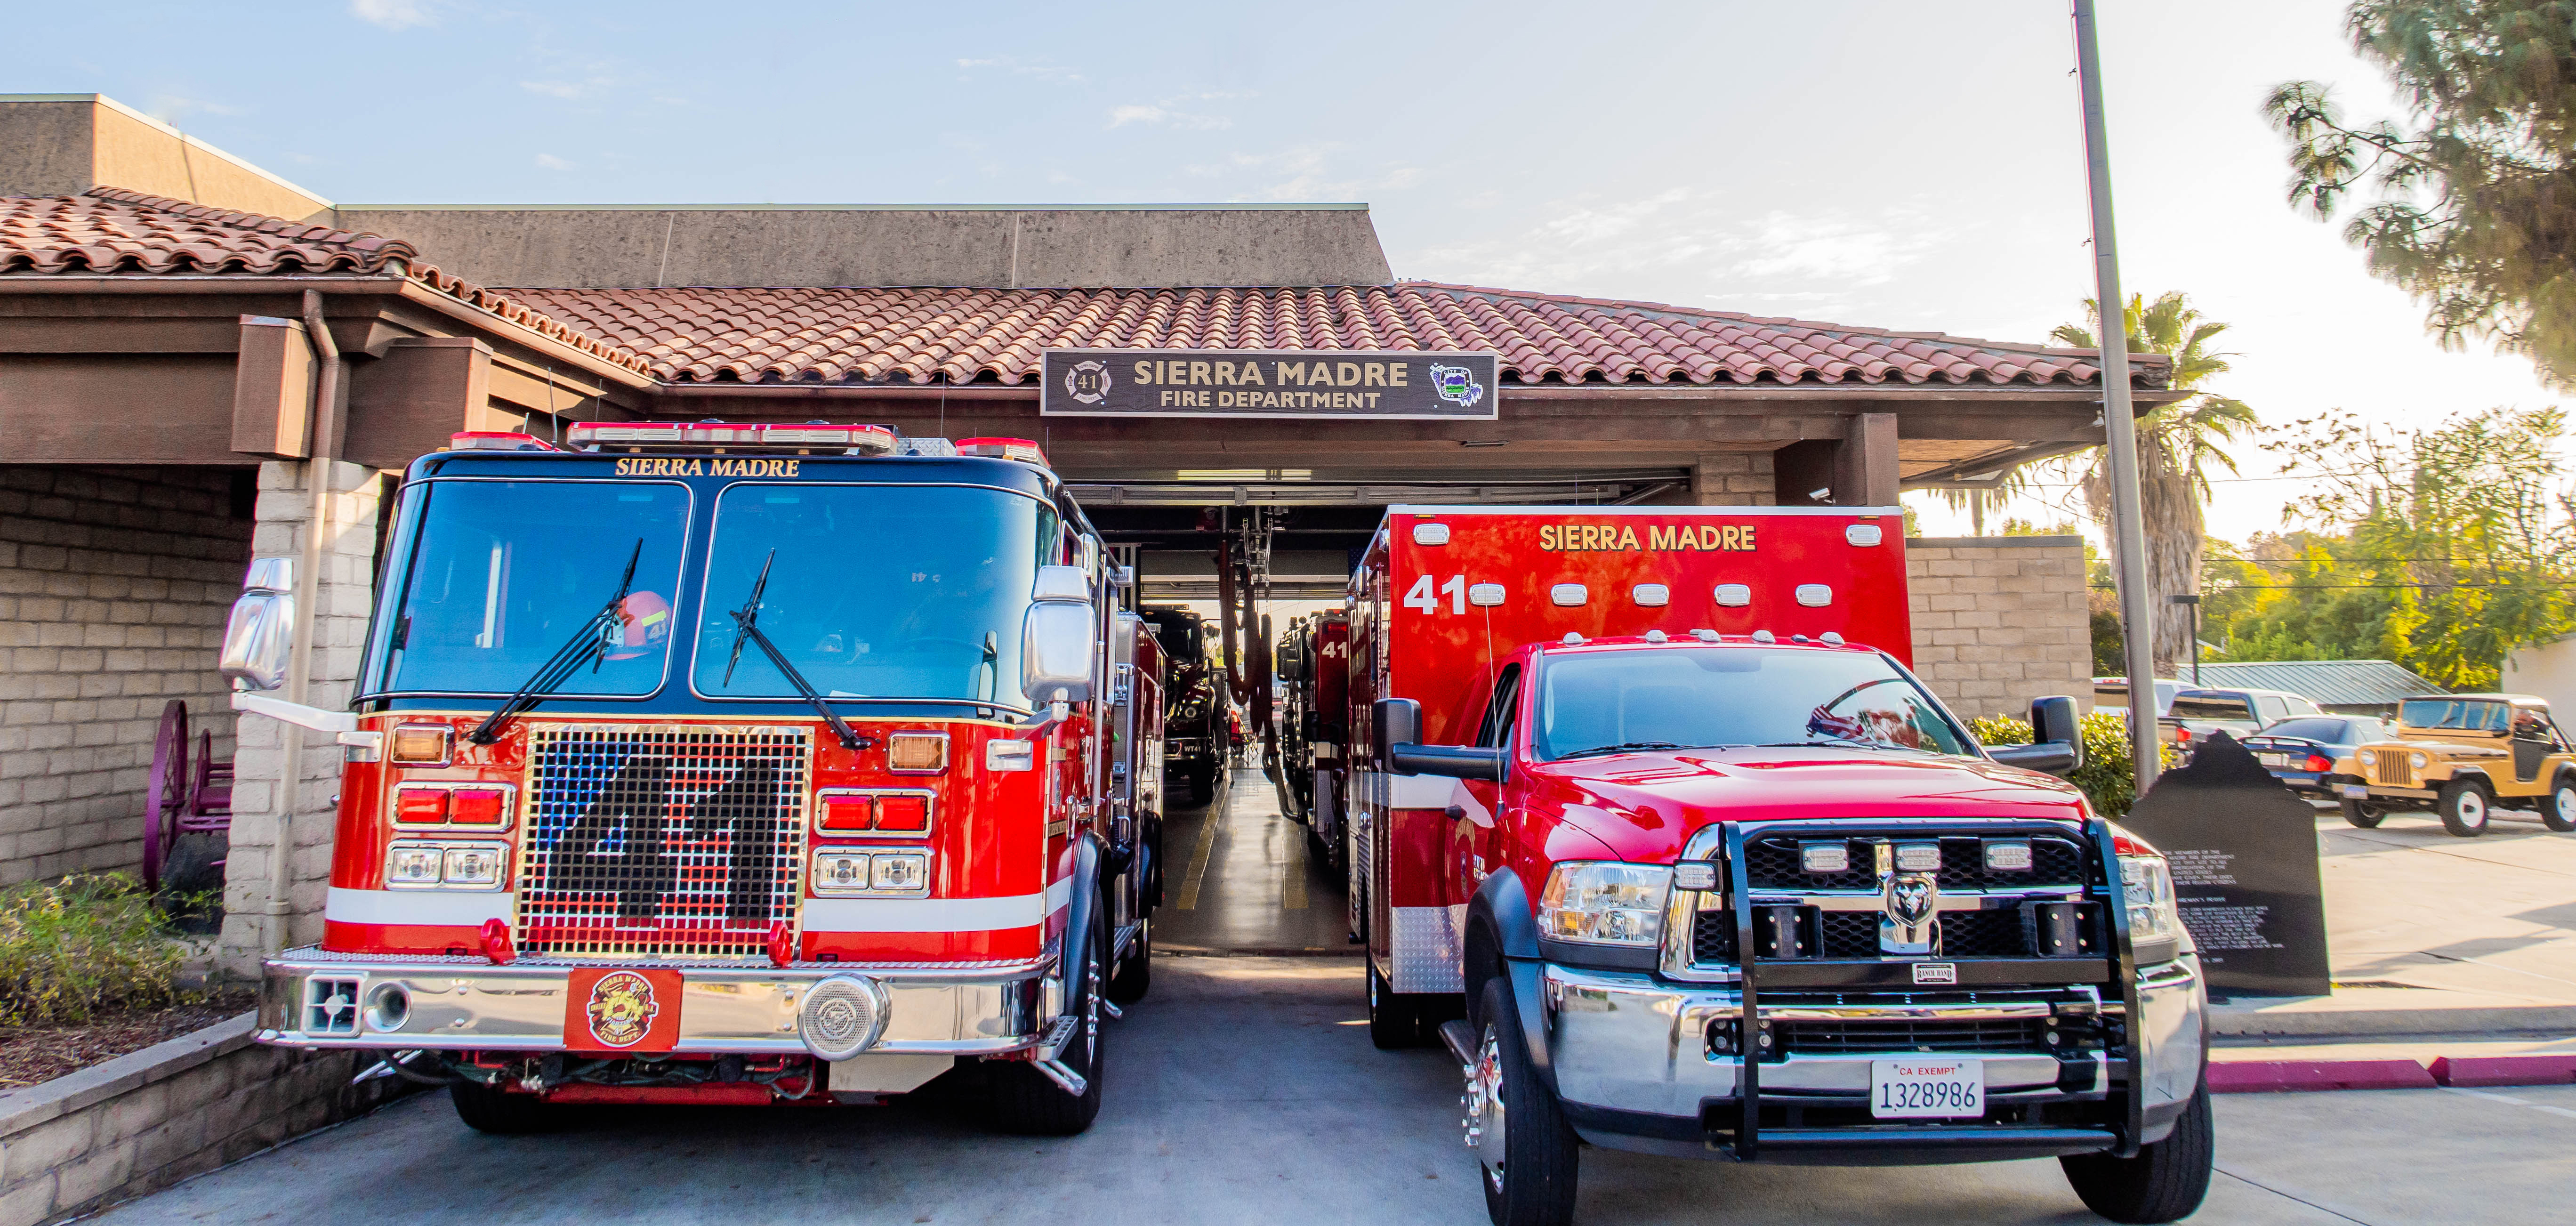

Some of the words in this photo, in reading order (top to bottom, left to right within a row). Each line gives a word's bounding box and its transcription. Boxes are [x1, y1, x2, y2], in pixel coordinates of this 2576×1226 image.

[1078, 374, 1097, 389] 41
[1134, 361, 1264, 386] SIERRA
[1277, 362, 1408, 387] MADRE
[1161, 391, 1211, 407] FIRE
[1218, 391, 1381, 408] DEPARTMENT
[615, 458, 703, 476] SIERRA
[709, 460, 799, 477] MADRE
[1540, 525, 1641, 551] SIERRA
[1650, 525, 1757, 552] MADRE
[1403, 575, 1466, 614] 41
[648, 623, 667, 639] 41
[1322, 641, 1347, 658] 41
[547, 755, 782, 931] 41
[1916, 969, 1935, 978] RANCH
[1936, 969, 1952, 978] HAND
[598, 976, 623, 992] SIERRA
[599, 1031, 617, 1042] FIRE
[619, 1032, 640, 1043] DEPT.
[613, 1027, 623, 1036] 41
[1900, 1067, 1913, 1076] CA
[1918, 1067, 1956, 1076] EXEMPT
[1881, 1082, 1976, 1108] 1328986
